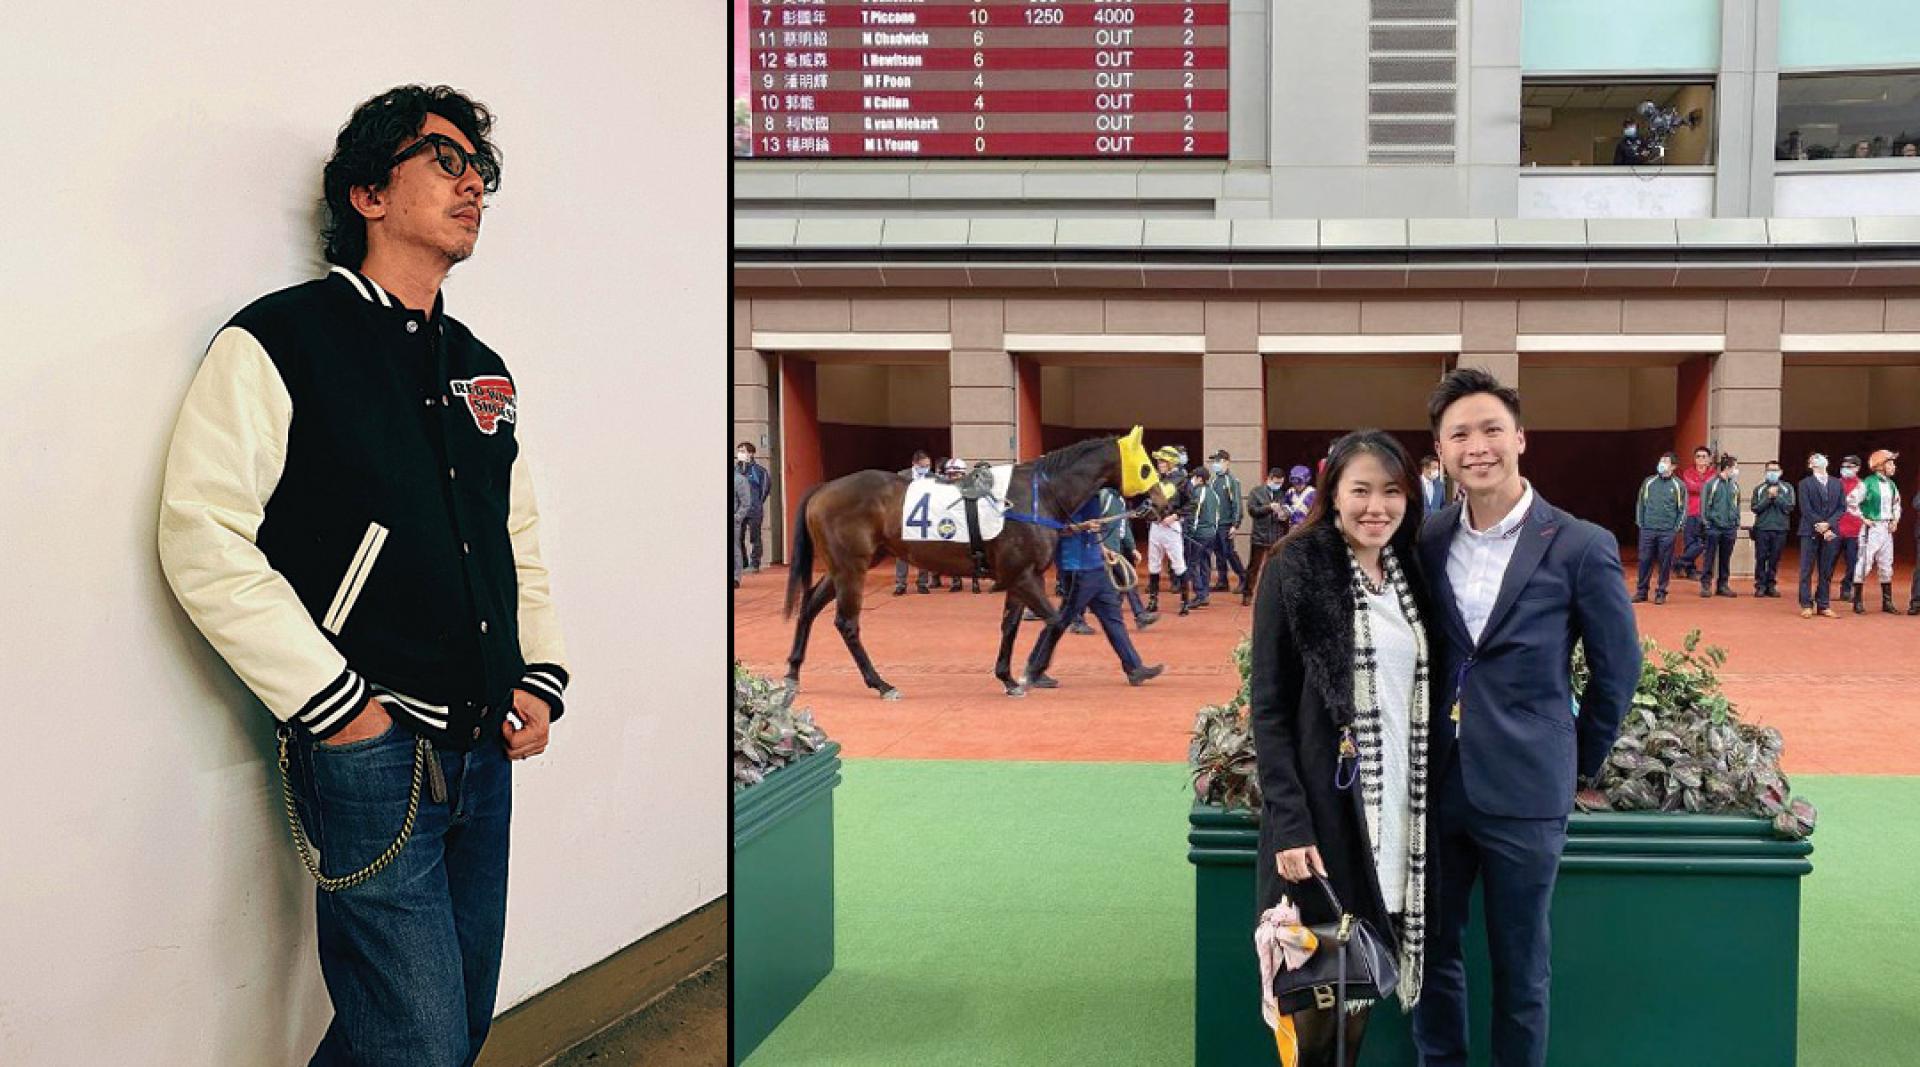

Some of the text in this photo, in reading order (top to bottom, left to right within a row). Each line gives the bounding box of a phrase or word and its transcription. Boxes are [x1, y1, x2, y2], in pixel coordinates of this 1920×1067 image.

[762, 10, 771, 25] 7
[861, 10, 868, 23] T
[969, 9, 988, 24] 10
[1024, 9, 1064, 24] 1250
[1094, 9, 1134, 24] 4000
[1183, 9, 1194, 24] 2
[758, 31, 775, 47] 11
[874, 32, 929, 46] Chadwick
[973, 30, 984, 46] 6
[1096, 30, 1133, 45] OUT
[1183, 29, 1194, 45] 2
[759, 52, 778, 68] 12
[973, 52, 984, 67] 6
[1096, 51, 1133, 66] OUT
[1183, 51, 1194, 66] 2
[763, 73, 773, 89] 9
[863, 74, 874, 88] M
[875, 74, 881, 88] F
[883, 74, 912, 88] Poon
[973, 73, 984, 88] 4
[1096, 72, 1133, 87] OUT
[1183, 72, 1194, 88] 2
[761, 94, 779, 110] 10
[973, 95, 984, 110] 4
[1096, 93, 1133, 109] OUT
[1184, 93, 1193, 109] 1
[764, 116, 774, 131] 8
[975, 115, 984, 131] 0
[1096, 115, 1133, 130] OUT
[1183, 115, 1194, 131] 2
[761, 137, 780, 152] 13
[864, 138, 875, 152] M
[975, 136, 985, 152] 0
[1096, 136, 1133, 151] OUT
[1183, 136, 1194, 152] 2
[906, 492, 932, 539] 4
